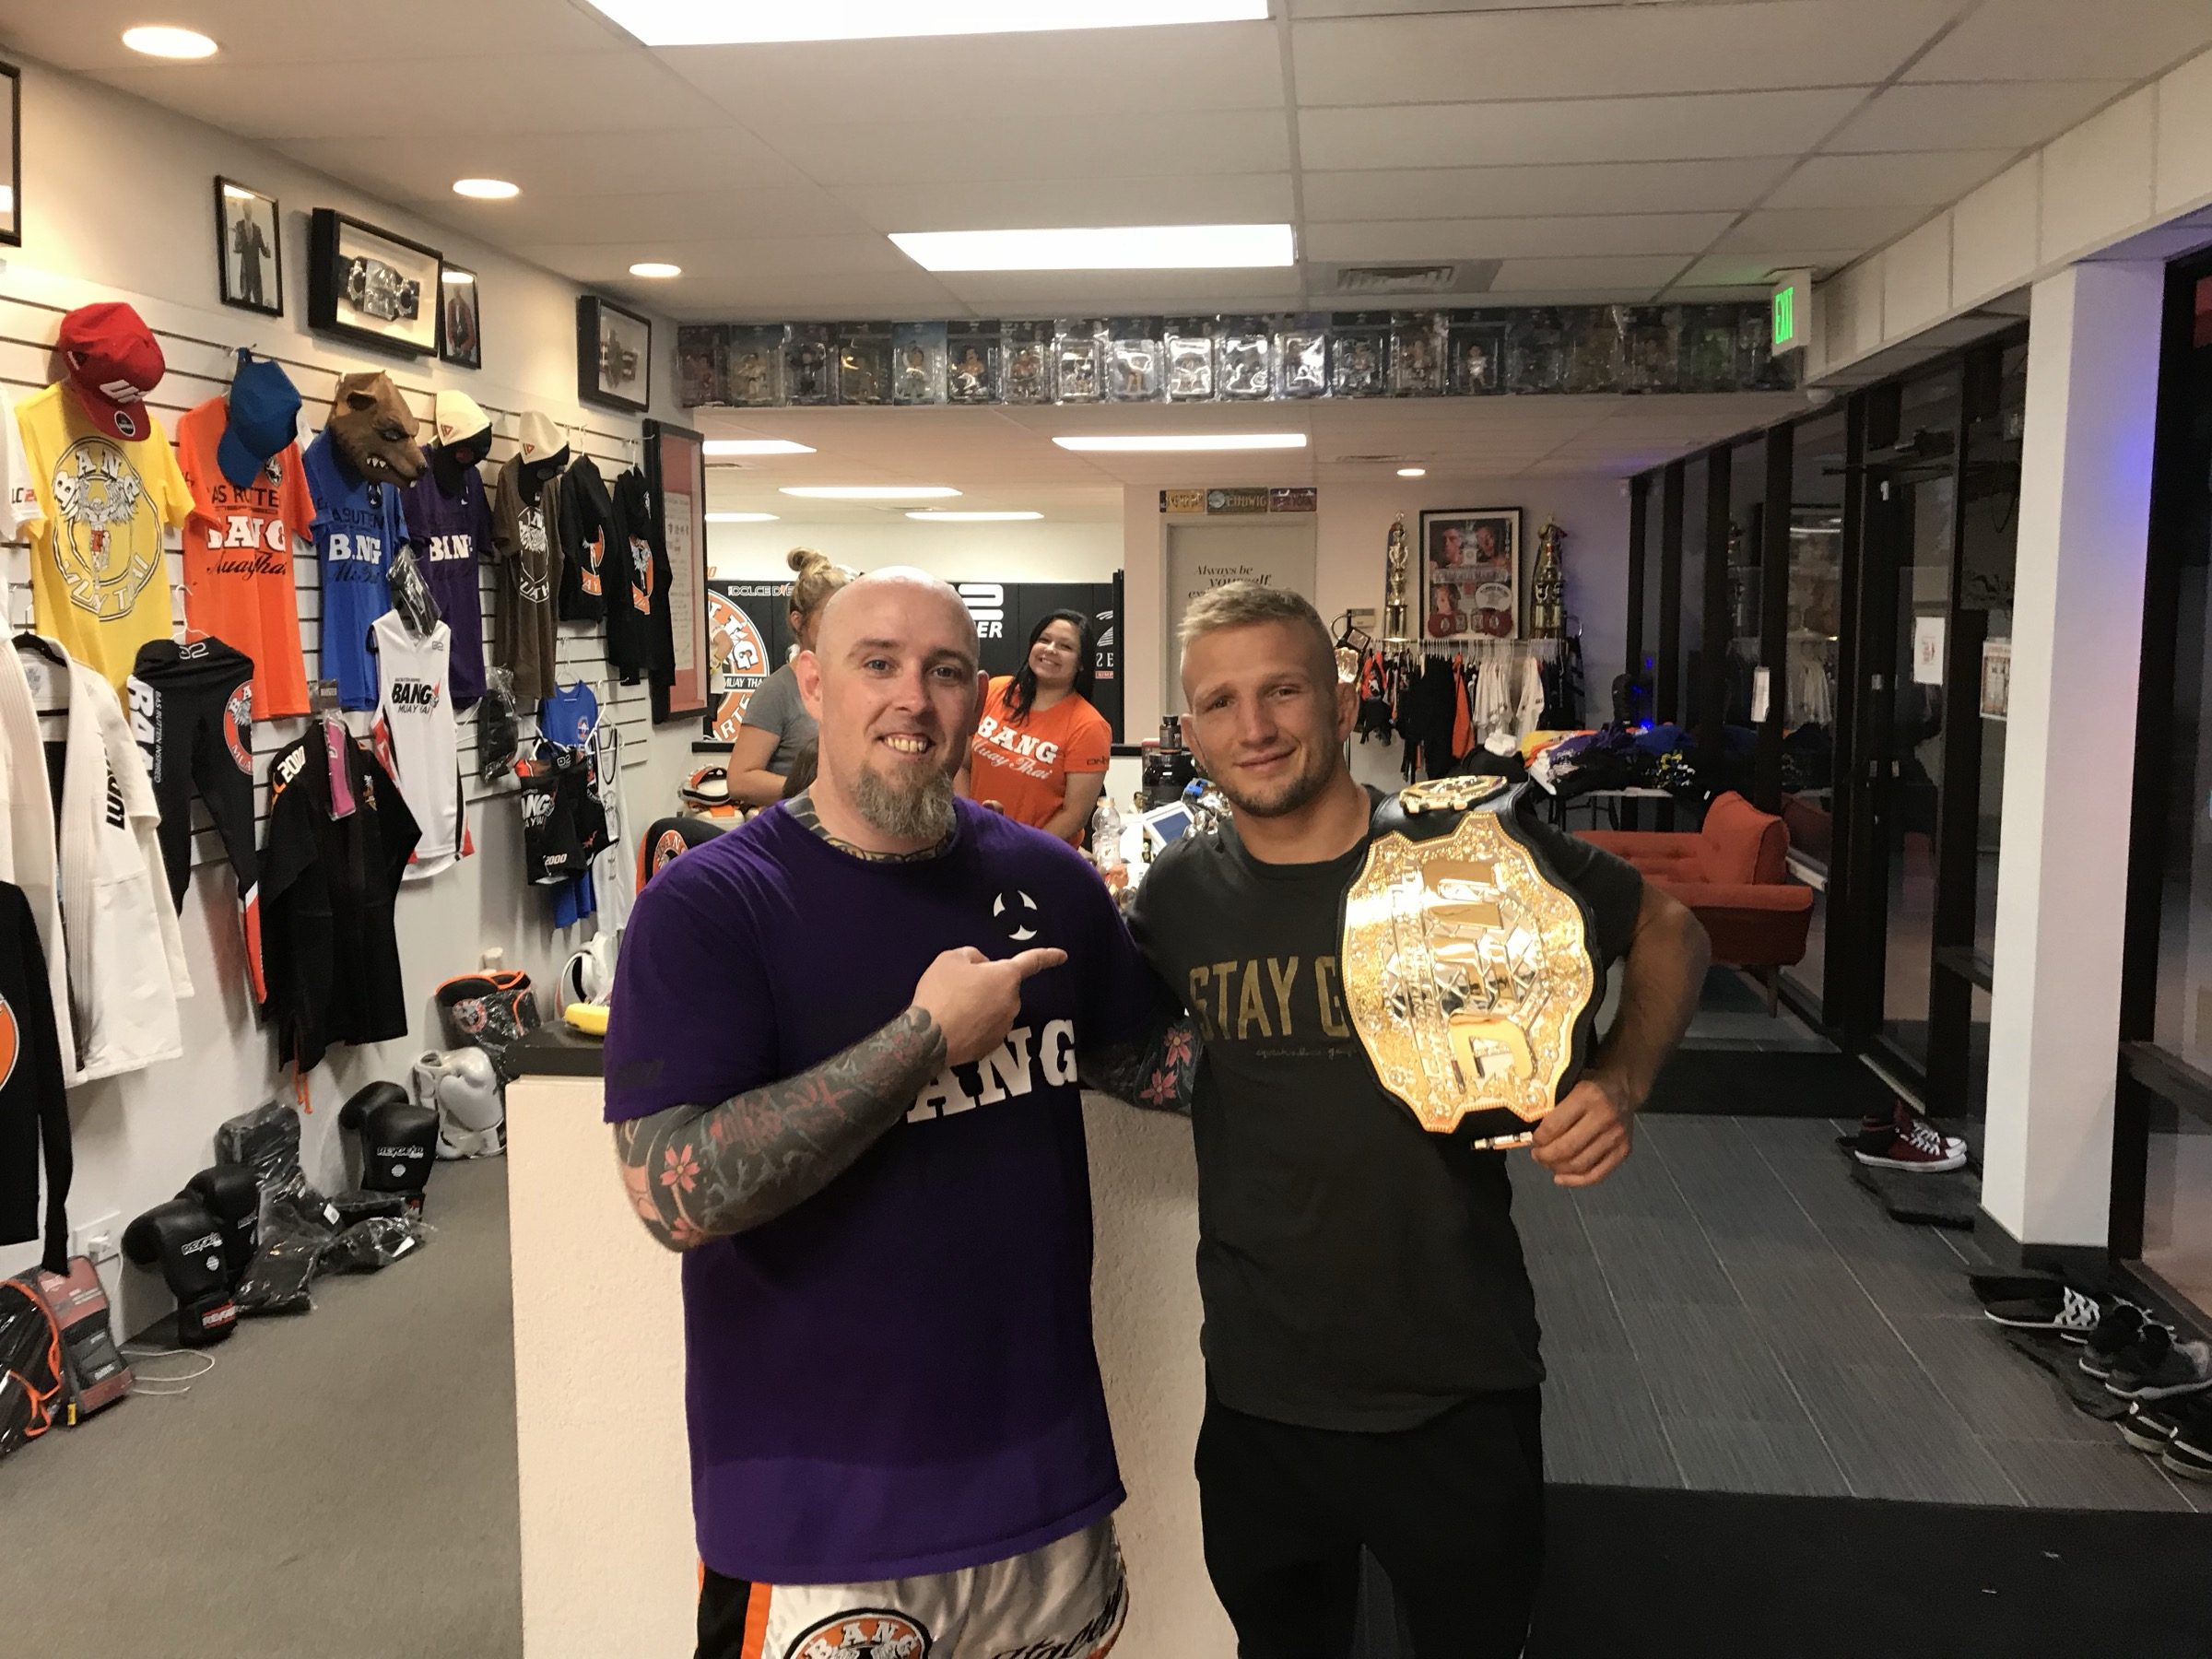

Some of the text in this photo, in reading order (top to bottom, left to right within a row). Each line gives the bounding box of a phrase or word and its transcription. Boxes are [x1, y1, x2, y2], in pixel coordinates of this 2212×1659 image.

[1775, 287, 1794, 344] EXIT
[329, 533, 382, 565] BNG
[1195, 565, 1253, 579] Always be
[1208, 573, 1273, 587] youlf
[733, 586, 771, 596] DOLCE
[975, 621, 1003, 638] ER
[392, 683, 432, 704] BANG
[747, 677, 764, 688] THA
[229, 686, 253, 715] BA
[978, 716, 1059, 764] BANG
[1189, 955, 1350, 1041] STAY G
[907, 1018, 1077, 1124] ANG
